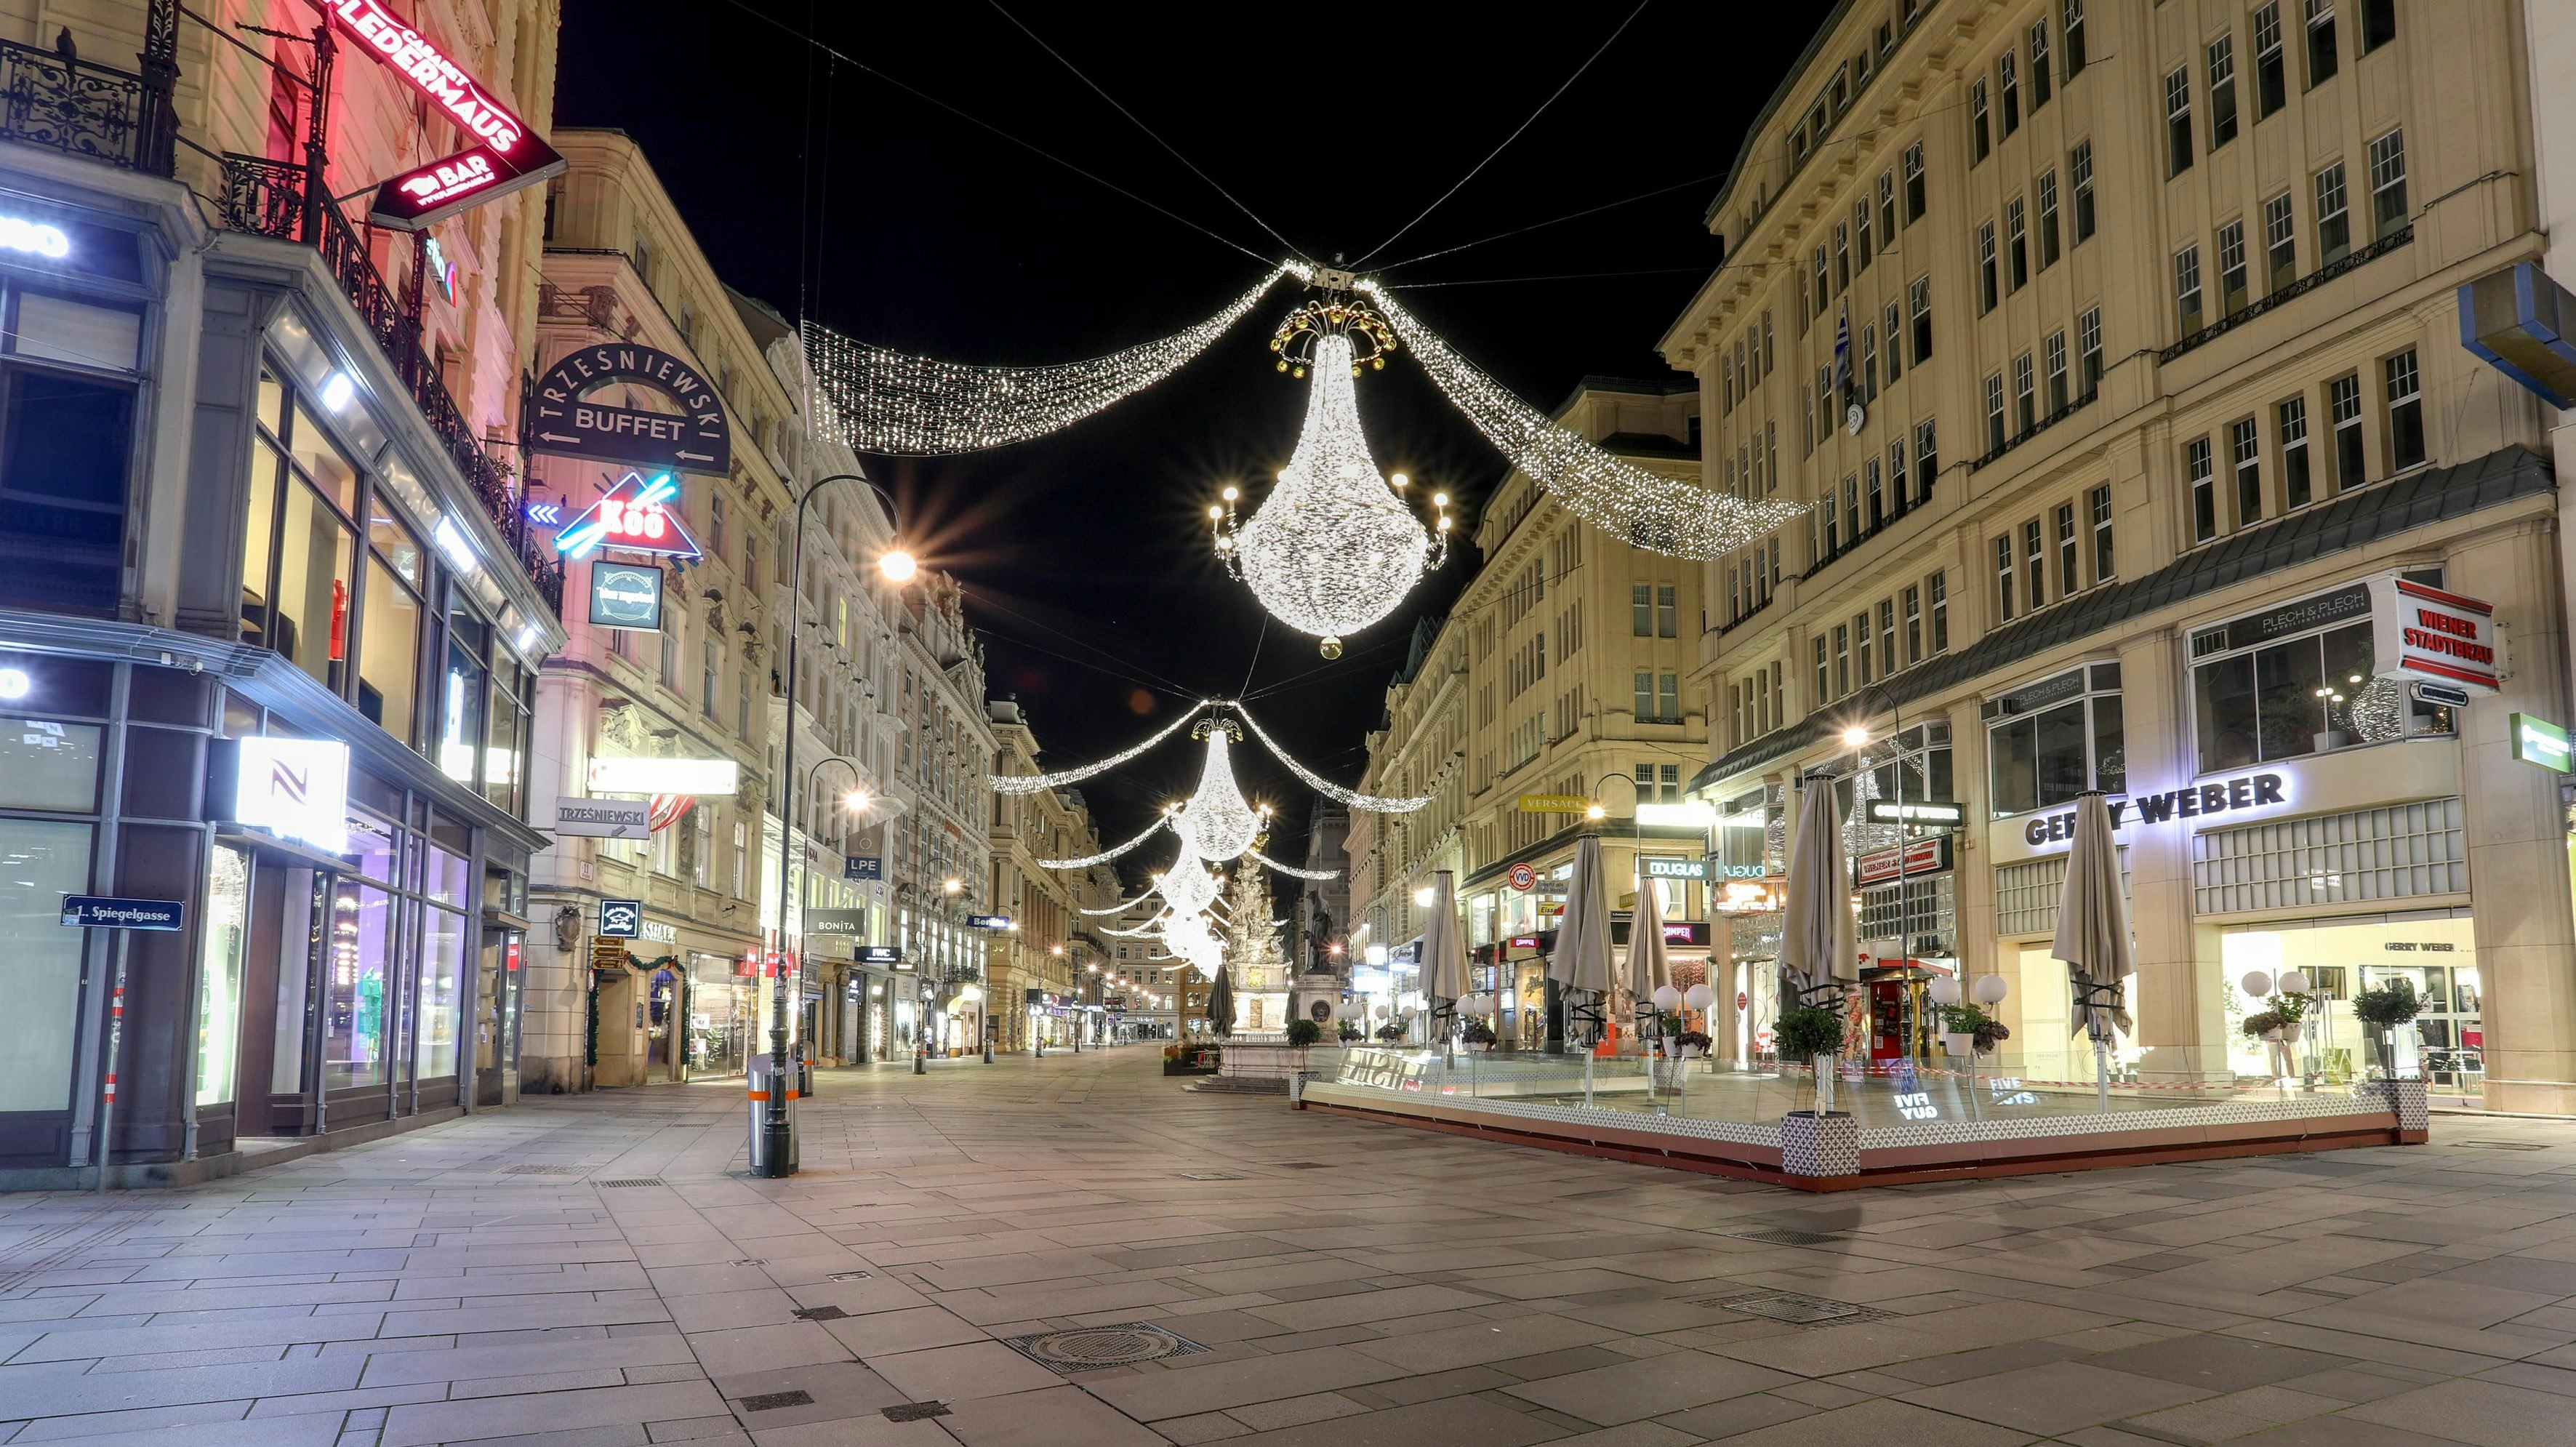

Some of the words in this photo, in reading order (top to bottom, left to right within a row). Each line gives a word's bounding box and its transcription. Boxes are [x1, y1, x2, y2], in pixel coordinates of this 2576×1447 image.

[322, 0, 518, 152] LEDERMAUS
[436, 155, 491, 188] BAR
[575, 408, 685, 441] BUFFET
[2263, 608, 2305, 629] PLECH
[2308, 606, 2316, 616] &
[2319, 591, 2364, 614] PLECH
[2417, 607, 2478, 640] WIENER
[2019, 688, 2045, 703] PLECH
[2045, 686, 2052, 694] &
[2052, 676, 2079, 692] PLECH
[271, 758, 309, 806] N
[1527, 798, 1583, 809] VERSACE
[2026, 801, 2127, 846] GERY
[2136, 773, 2287, 825] WEBER
[850, 859, 876, 871] LPE
[1649, 862, 1703, 876] DOUGLAS
[1863, 860, 1890, 873] WIENER
[1515, 873, 1529, 881] VVD
[92, 905, 171, 922] Spiegelgasse
[1515, 938, 1535, 947] CAMPER
[2384, 942, 2418, 951] GERRY
[2419, 942, 2455, 952] WEBER
[872, 948, 891, 957] IWC
